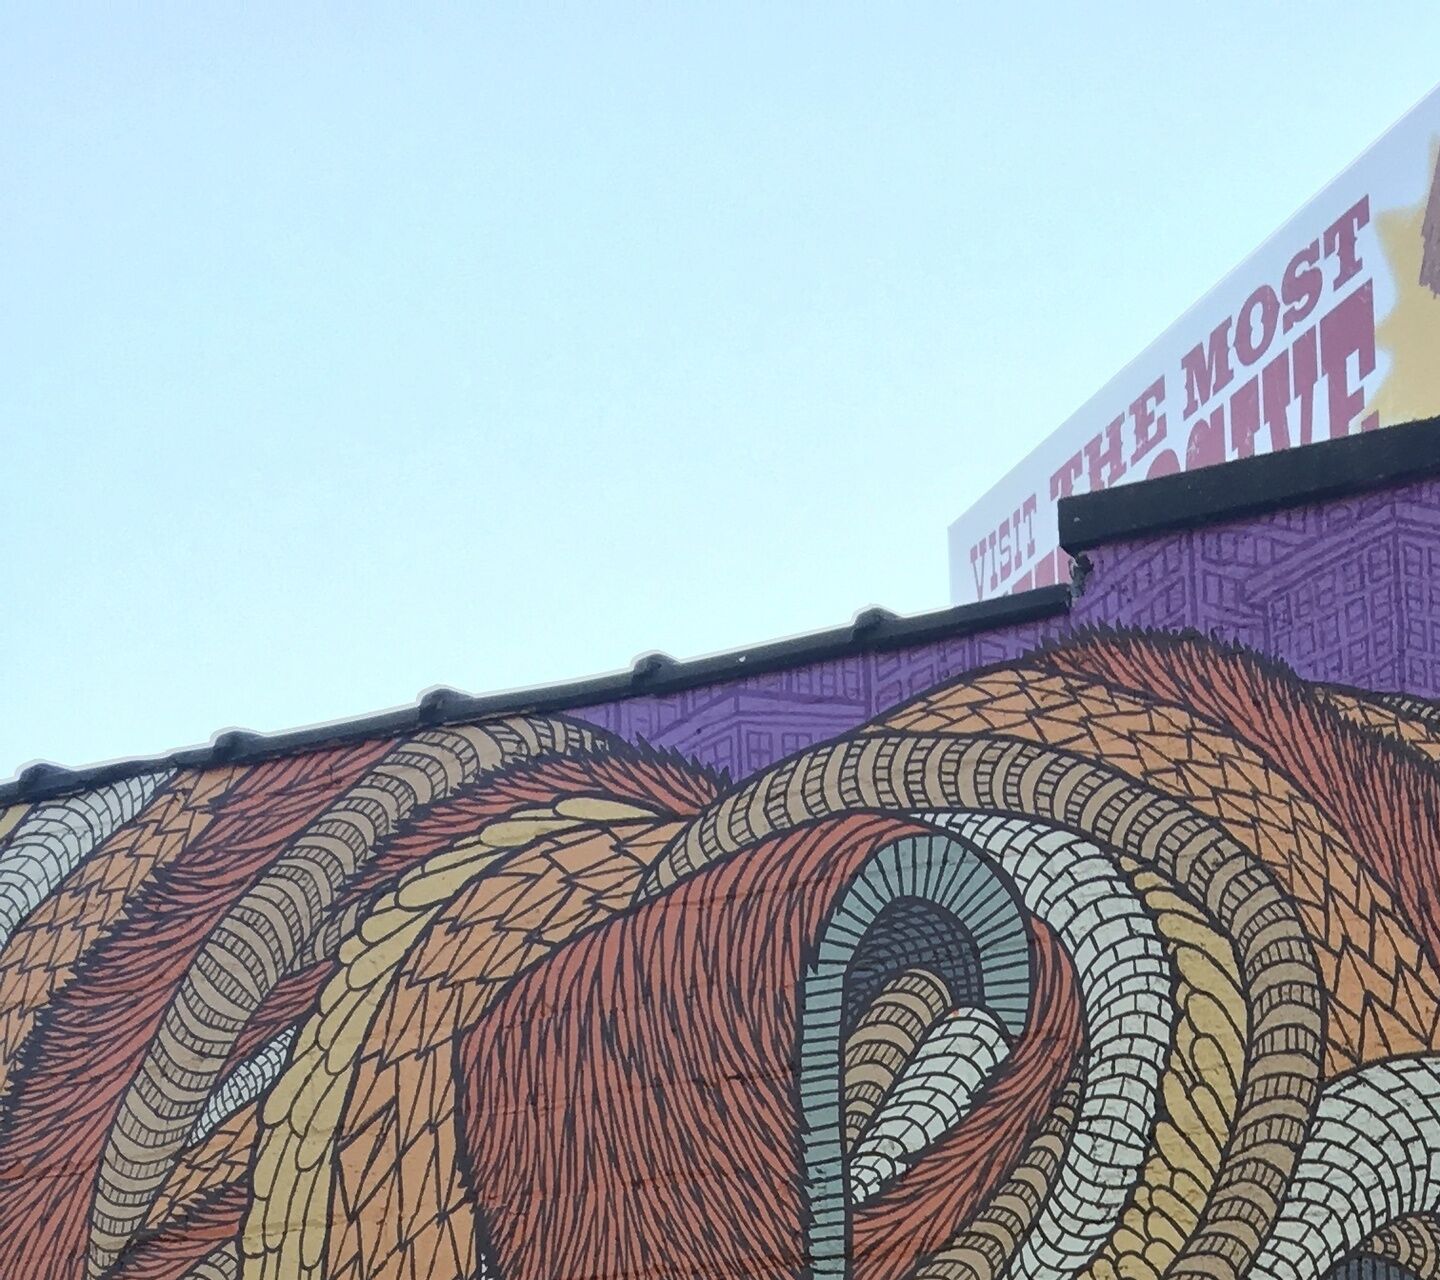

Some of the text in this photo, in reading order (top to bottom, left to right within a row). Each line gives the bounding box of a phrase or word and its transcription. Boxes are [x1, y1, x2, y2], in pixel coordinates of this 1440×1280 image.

[969, 493, 1037, 602] VISIT
[1049, 374, 1168, 501] THE
[1180, 193, 1370, 422] MOST
